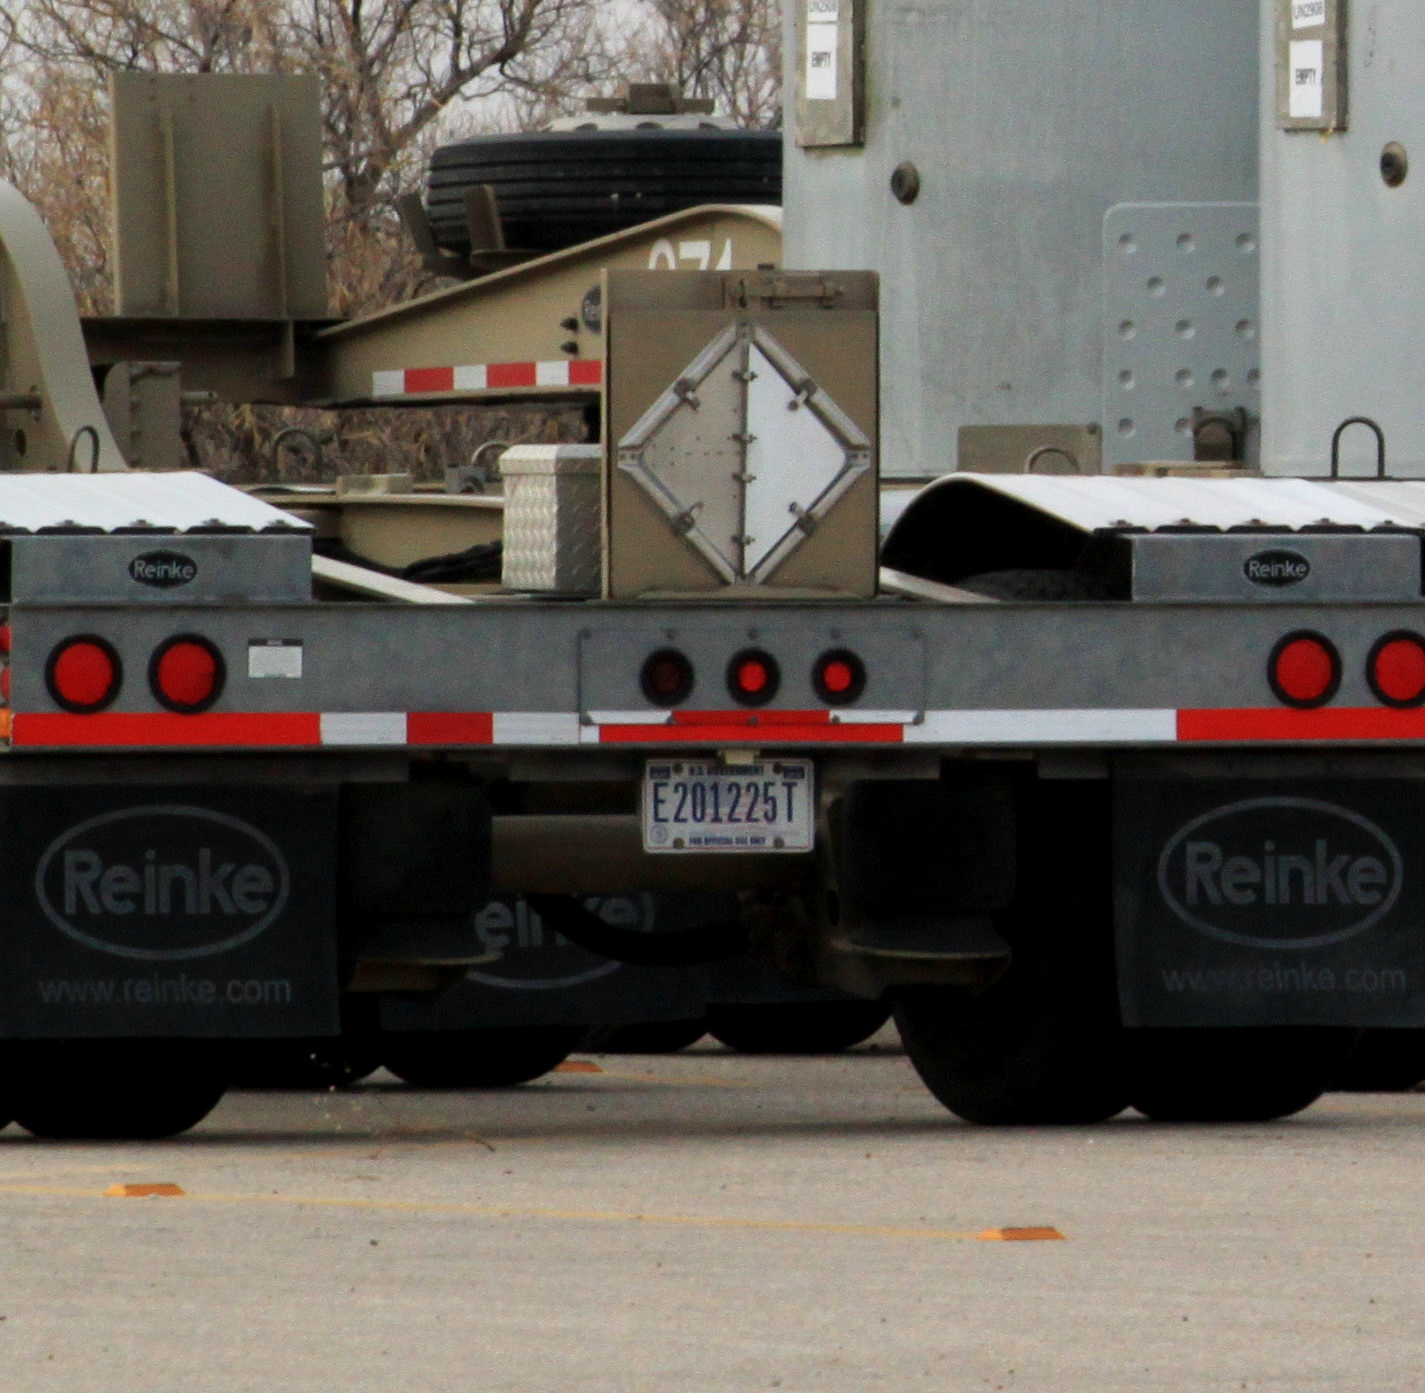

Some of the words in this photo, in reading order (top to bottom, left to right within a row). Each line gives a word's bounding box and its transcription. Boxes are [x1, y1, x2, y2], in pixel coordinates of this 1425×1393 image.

[133, 560, 195, 579] Reinke
[1248, 559, 1307, 577] Reinke
[653, 781, 797, 823] E201225T
[64, 848, 274, 915] Reinke
[1184, 840, 1388, 906] Reinke
[40, 975, 292, 1005] www.reinke.com
[1161, 962, 1407, 994] www.reinke.com
